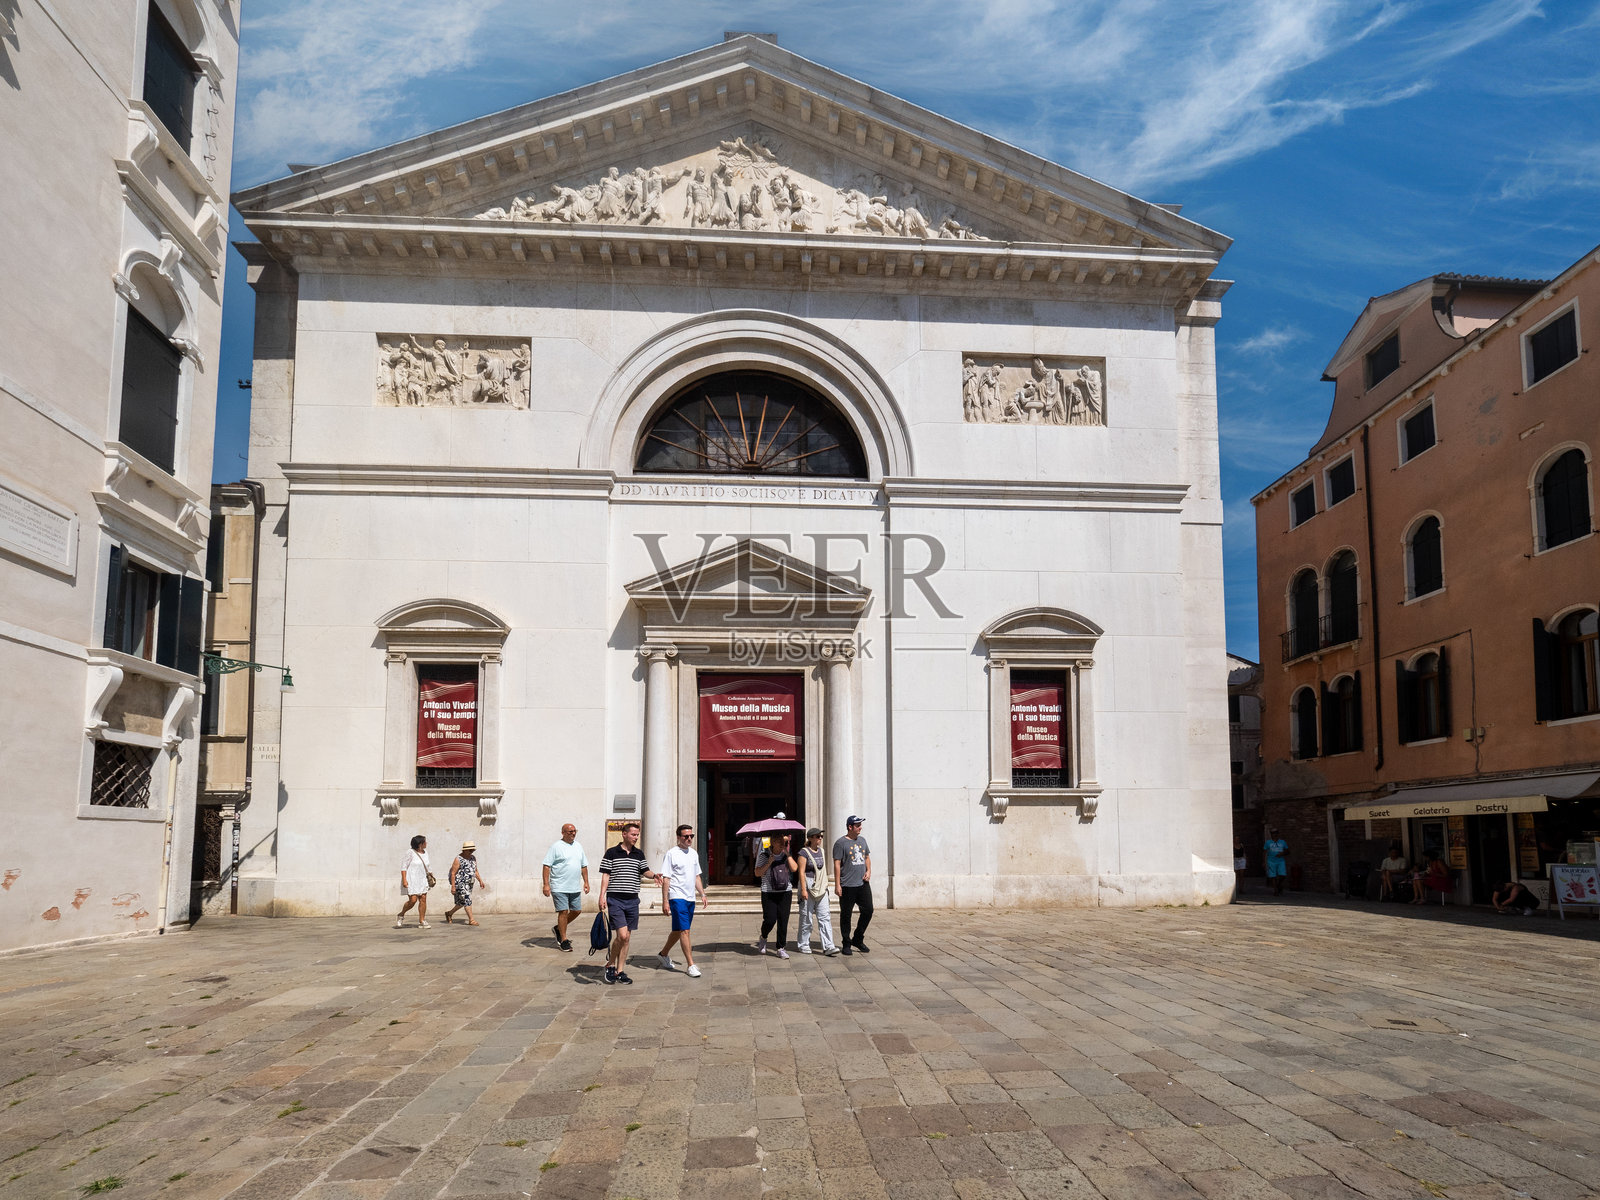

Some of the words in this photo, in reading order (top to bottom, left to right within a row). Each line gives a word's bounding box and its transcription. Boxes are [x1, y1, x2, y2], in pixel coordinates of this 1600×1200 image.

[813, 489, 879, 501] DICATVM
[423, 700, 450, 710] Antonio
[712, 704, 738, 712] Museo
[740, 704, 760, 712] della
[762, 704, 790, 712] Musica
[1011, 704, 1038, 712] Antonio
[1038, 704, 1062, 712] Vivaldi
[430, 710, 435, 718] il
[437, 710, 452, 719] suo
[453, 711, 476, 720] tempo
[1018, 713, 1024, 722] il
[1039, 714, 1061, 722] tempo
[438, 722, 460, 731] Museo
[427, 731, 444, 739] della
[445, 731, 472, 739] Musica
[1413, 806, 1450, 816] Gelateria
[1476, 804, 1508, 812] Pastry
